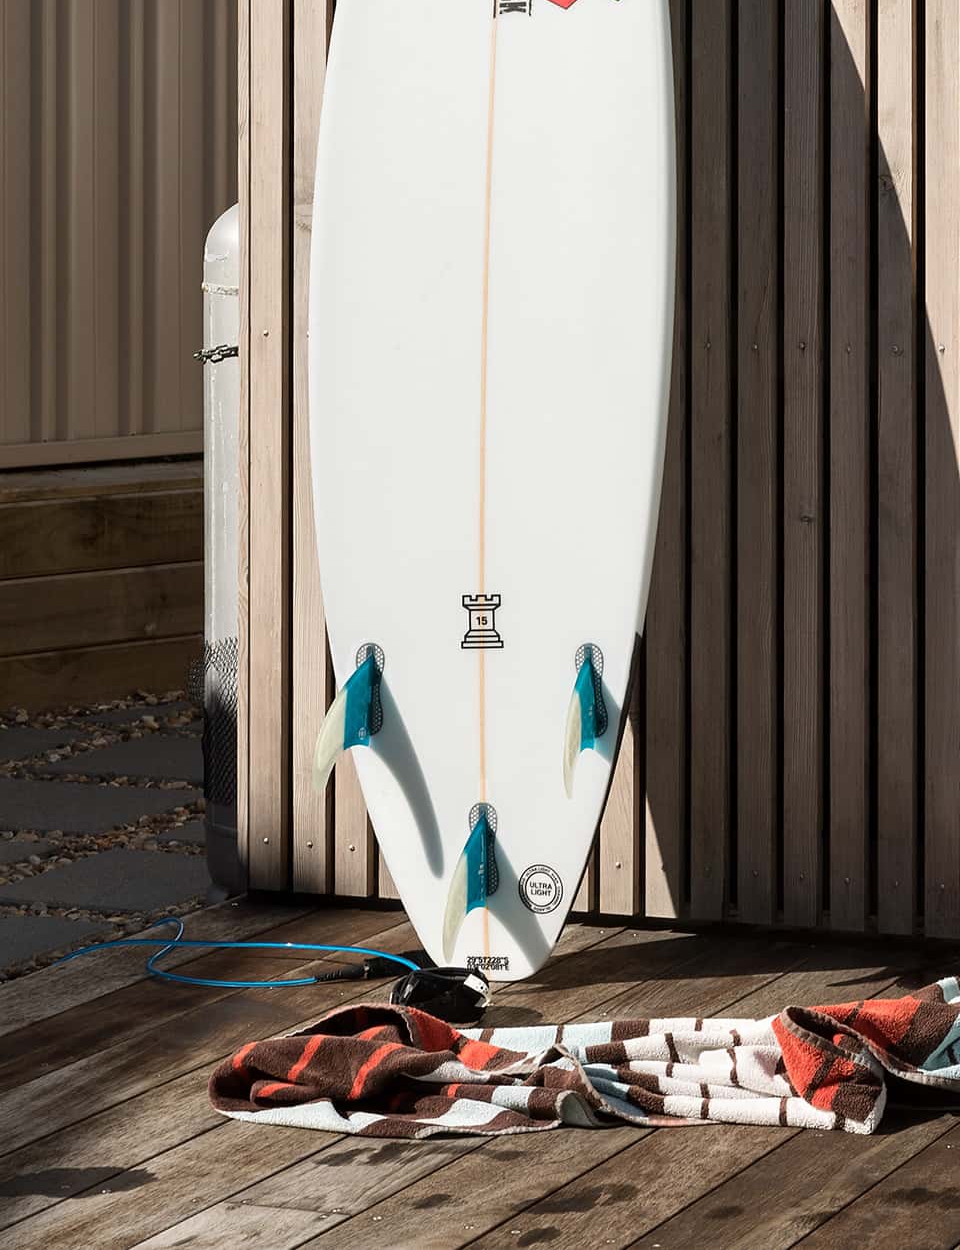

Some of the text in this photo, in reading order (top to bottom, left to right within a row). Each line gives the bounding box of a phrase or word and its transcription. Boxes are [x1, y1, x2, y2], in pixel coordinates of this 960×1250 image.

[476, 616, 488, 625] 15
[530, 881, 552, 890] ULTRA
[530, 889, 551, 897] LIGHT
